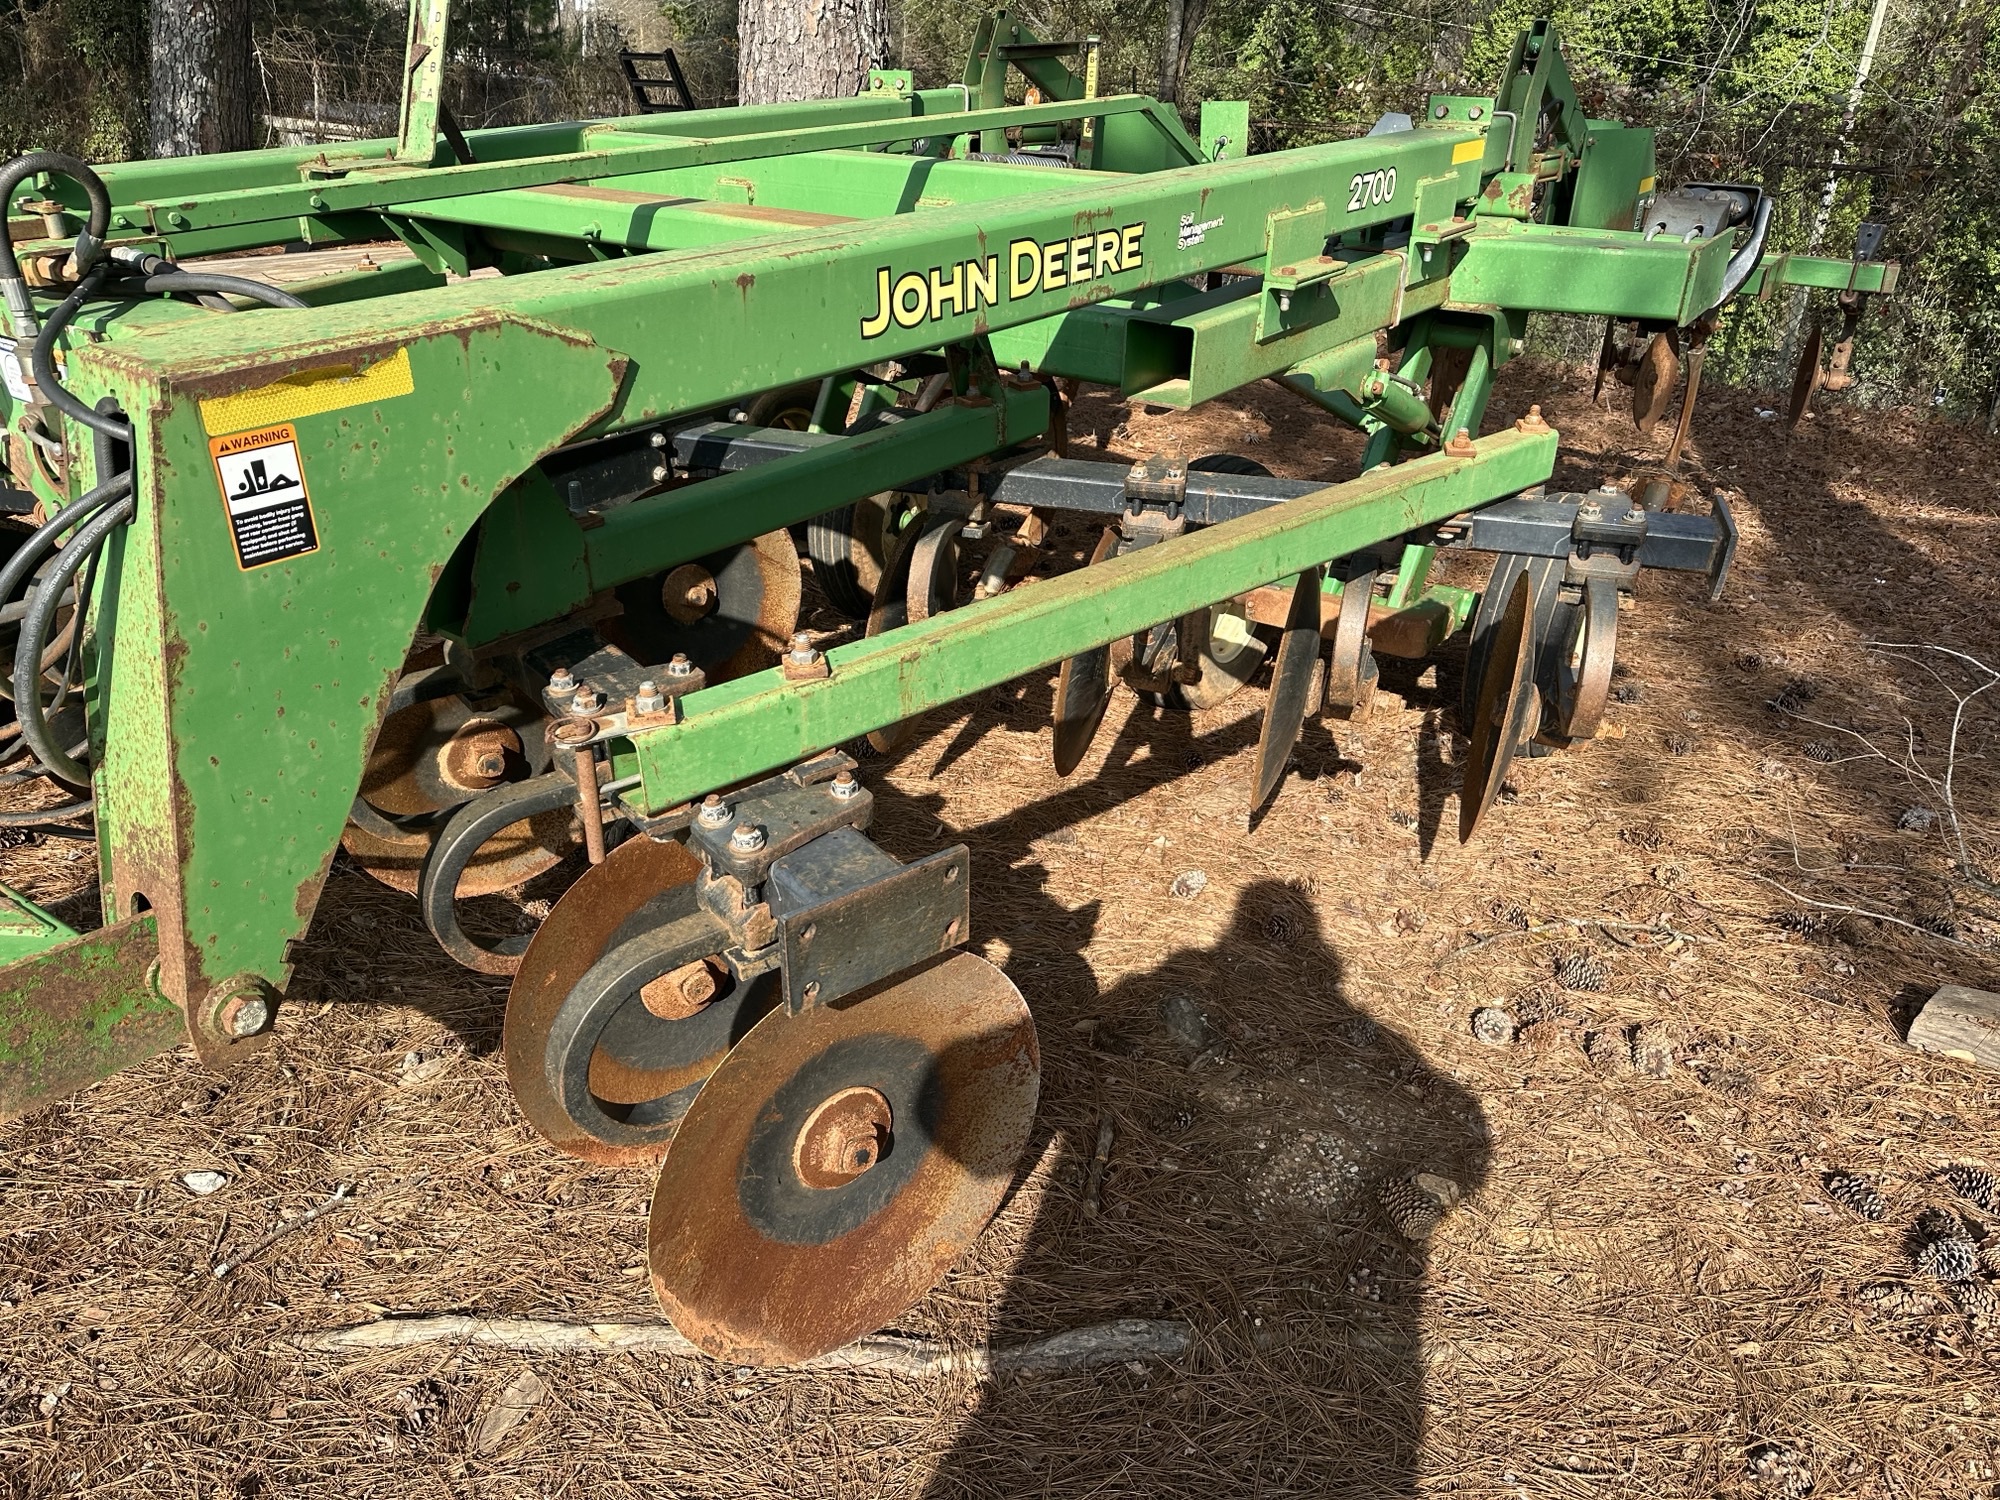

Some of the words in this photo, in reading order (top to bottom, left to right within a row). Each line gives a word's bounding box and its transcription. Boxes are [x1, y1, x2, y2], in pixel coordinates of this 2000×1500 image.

[433, 36, 440, 47] C
[430, 62, 437, 72] B
[427, 87, 433, 98] A
[1347, 166, 1397, 213] 2700
[1179, 214, 1224, 238] Management
[1180, 210, 1195, 226] Soil
[1177, 234, 1205, 251] System
[860, 253, 999, 340] JOHN
[1009, 221, 1147, 301] DEERE
[230, 428, 290, 450] WARNING
